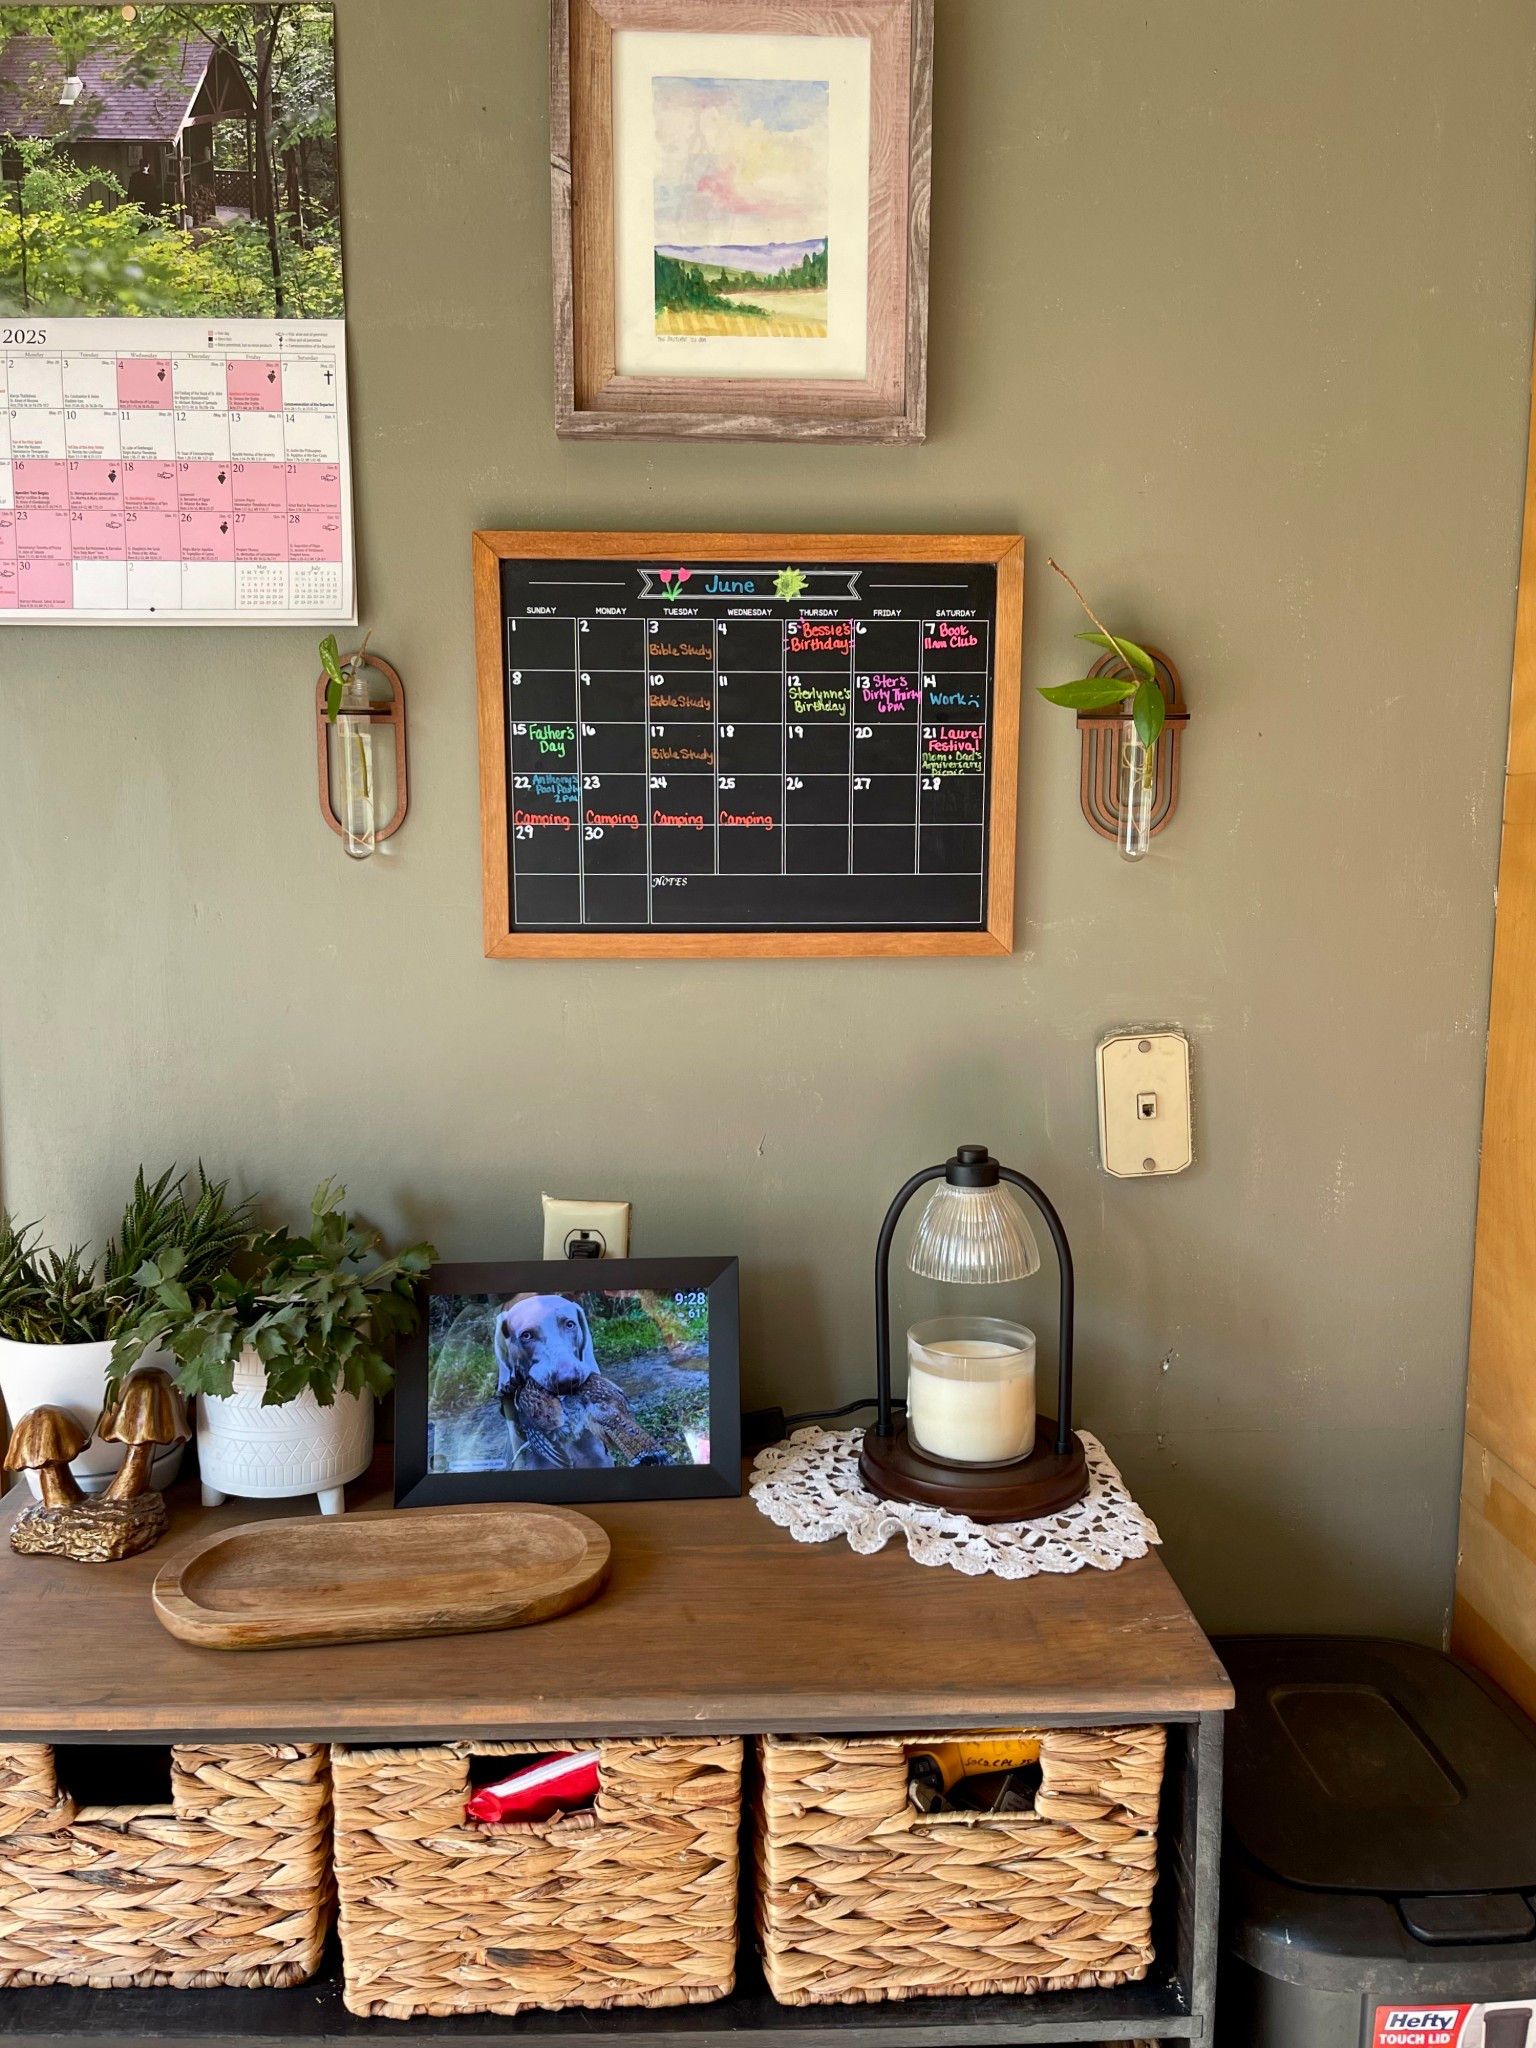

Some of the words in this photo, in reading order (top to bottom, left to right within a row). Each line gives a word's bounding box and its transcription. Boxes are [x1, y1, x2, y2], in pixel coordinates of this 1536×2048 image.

[2, 329, 47, 344] 2025
[8, 360, 14, 369] 2
[63, 360, 69, 369] 3
[118, 361, 124, 369] 4
[173, 361, 179, 370] 5
[228, 362, 234, 371] 6
[283, 363, 289, 372] 7
[11, 410, 17, 419] 9
[66, 410, 77, 420] 10
[121, 411, 130, 420] 11
[176, 412, 186, 421] 12
[231, 413, 241, 422] 13
[285, 414, 295, 423] 14
[14, 461, 24, 470] 16
[69, 462, 79, 471] 17
[124, 462, 134, 471] 18
[179, 463, 189, 472] 19
[233, 464, 244, 473] 20
[287, 464, 297, 473] 21
[17, 511, 28, 520] 23
[71, 512, 83, 521] 24
[126, 513, 137, 522] 25
[181, 513, 192, 522] 26
[235, 514, 246, 523] 27
[289, 514, 300, 523] 28
[19, 561, 31, 570] 30
[705, 575, 755, 593] June
[595, 607, 627, 615] MONDAY
[663, 608, 699, 616] TUESDAY
[727, 608, 772, 616] WEDNESDAY
[799, 608, 839, 616] THURSDAY
[873, 609, 902, 617] FRIDAY
[935, 609, 976, 617] SATURDAY
[511, 620, 516, 631] 1
[580, 620, 590, 632] 2
[649, 620, 659, 633] 3
[718, 623, 727, 635] 4
[787, 622, 798, 634] 5
[802, 622, 851, 637] Bessie's
[856, 621, 867, 634] 6
[925, 623, 936, 634] 7
[939, 622, 969, 637] Book
[790, 637, 849, 655] Birthday
[949, 635, 978, 648] Club
[650, 643, 680, 656] Bible
[680, 643, 712, 661] Study
[512, 671, 522, 685] 8
[580, 673, 591, 685] 9
[650, 674, 665, 686] 10
[719, 675, 728, 686] 11
[788, 675, 802, 687] 12
[856, 676, 871, 689] 13
[873, 675, 907, 688] Ster's
[923, 674, 936, 688] 14
[862, 688, 890, 703] Dirty
[892, 687, 922, 704] Thirty
[929, 692, 967, 706] Work
[650, 695, 678, 708] Bible
[678, 695, 711, 711] Study
[794, 700, 846, 716] Birthday
[512, 723, 527, 735] 15
[529, 723, 575, 740] Father's
[581, 723, 596, 736] 16
[650, 725, 665, 737] 17
[720, 725, 735, 738] 18
[788, 725, 804, 739] 19
[854, 727, 873, 739] 20
[923, 727, 936, 739] 21
[940, 725, 983, 740] Laurel
[540, 740, 566, 758] Day
[928, 739, 979, 752] Festival
[651, 748, 680, 760] Bible
[681, 748, 714, 766] Study
[922, 752, 947, 761] Mom
[955, 750, 982, 761] Dad's
[922, 760, 982, 772] Anniversary
[513, 776, 531, 789] 22
[532, 773, 579, 786] Anthony's
[583, 776, 600, 790] 23
[649, 776, 667, 789] 24
[718, 777, 736, 790] 25
[786, 777, 803, 790] 26
[853, 777, 871, 790] 27
[922, 777, 941, 791] 28
[535, 784, 555, 795] Pool
[556, 784, 582, 797] Party
[514, 809, 570, 831] Camping
[586, 809, 639, 829] Camping
[653, 810, 704, 831] Camping
[719, 810, 774, 831] Camping
[515, 825, 534, 839] 29
[584, 826, 604, 840] 30
[652, 876, 688, 888] NOTES
[675, 1292, 706, 1305] 9:28
[1389, 2013, 1454, 2029] Hefty
[1379, 2033, 1425, 2044] TOUCH
